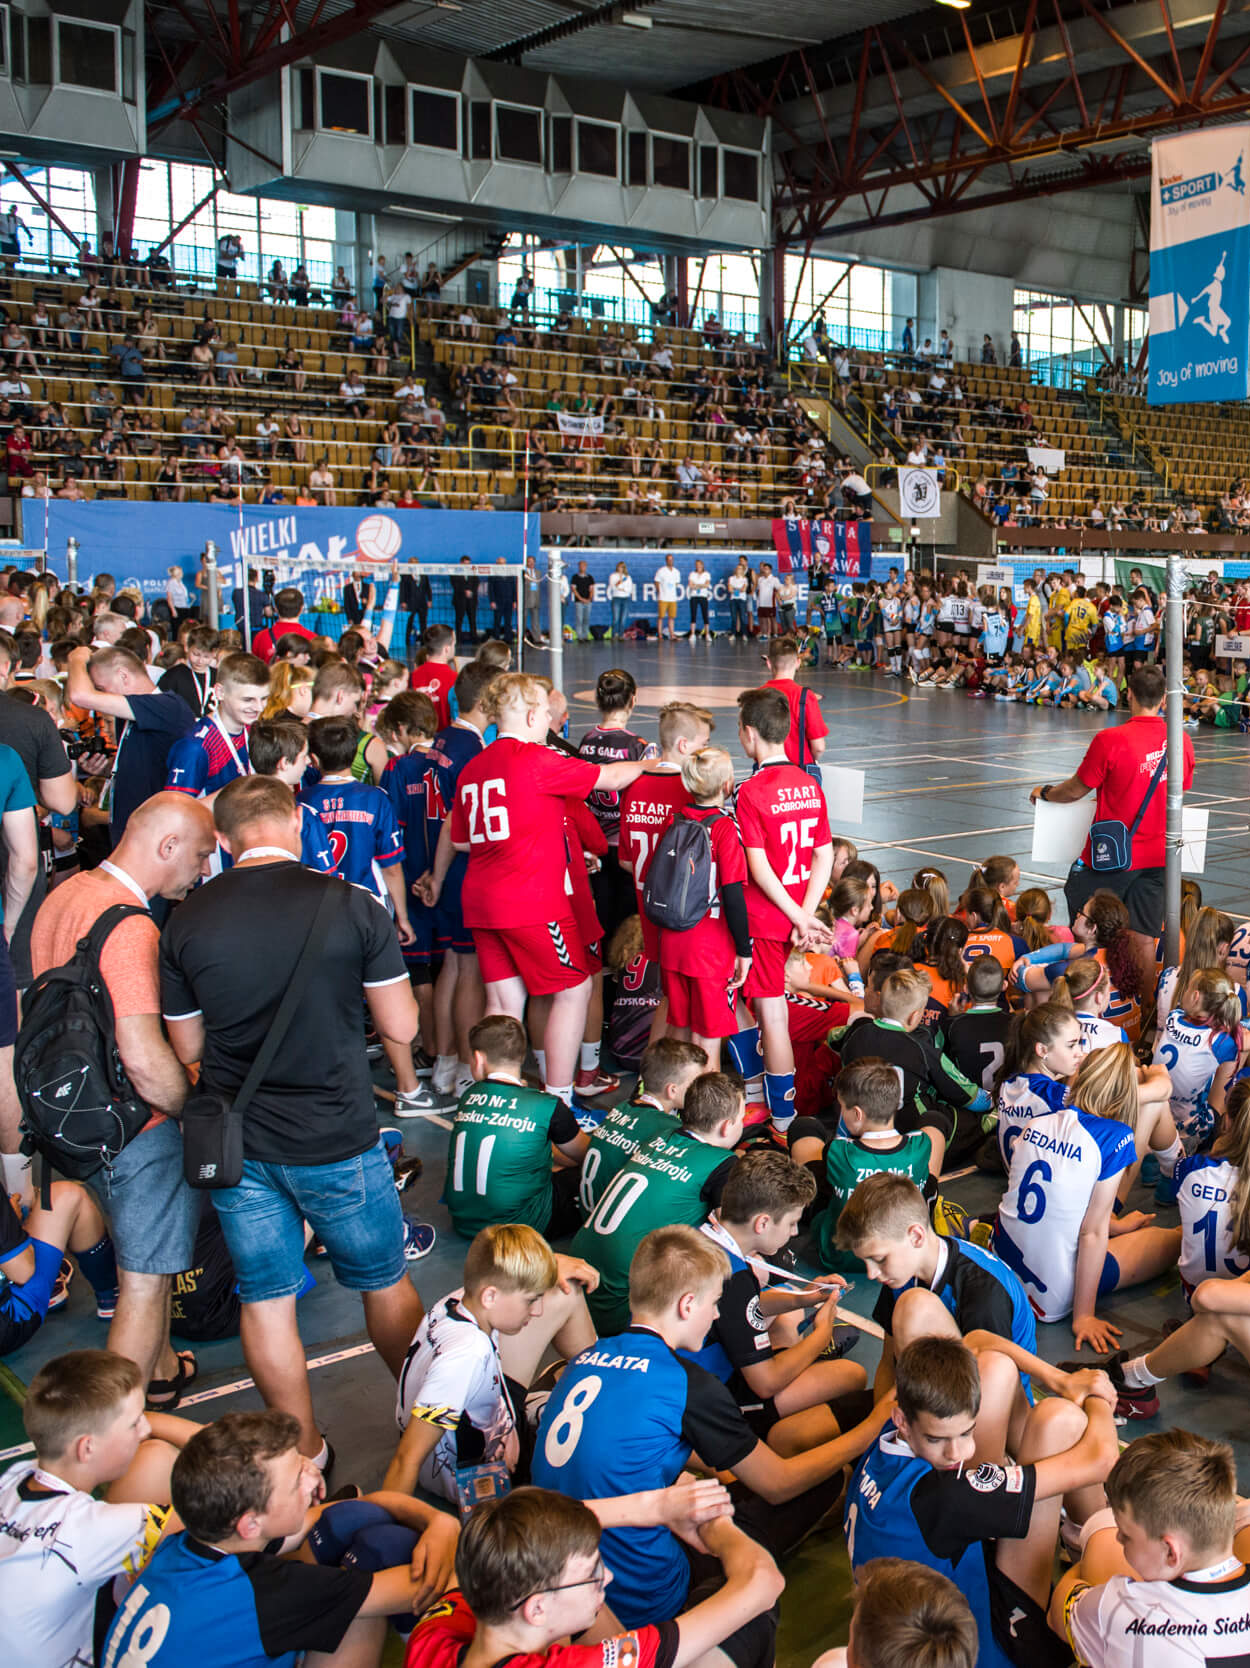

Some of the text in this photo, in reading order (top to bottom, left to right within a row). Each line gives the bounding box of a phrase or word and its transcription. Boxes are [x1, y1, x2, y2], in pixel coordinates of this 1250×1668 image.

[1156, 356, 1238, 387] Joy of moving
[230, 515, 298, 560] WIELKI
[788, 519, 857, 539] SPARTA
[461, 777, 511, 844] 26
[629, 800, 672, 816] START
[777, 785, 817, 801] START
[780, 817, 819, 886] 25
[623, 952, 649, 992] 9
[466, 1093, 518, 1110] ZPO Nr 1
[629, 1116, 639, 1131] 1
[677, 1147, 689, 1159] 1
[1022, 1127, 1083, 1162] GEDANIA
[454, 1130, 497, 1196] 11
[584, 1168, 649, 1235] 10
[1016, 1159, 1053, 1225] 6
[544, 1374, 603, 1468] 8
[1124, 1617, 1208, 1637] Akademia
